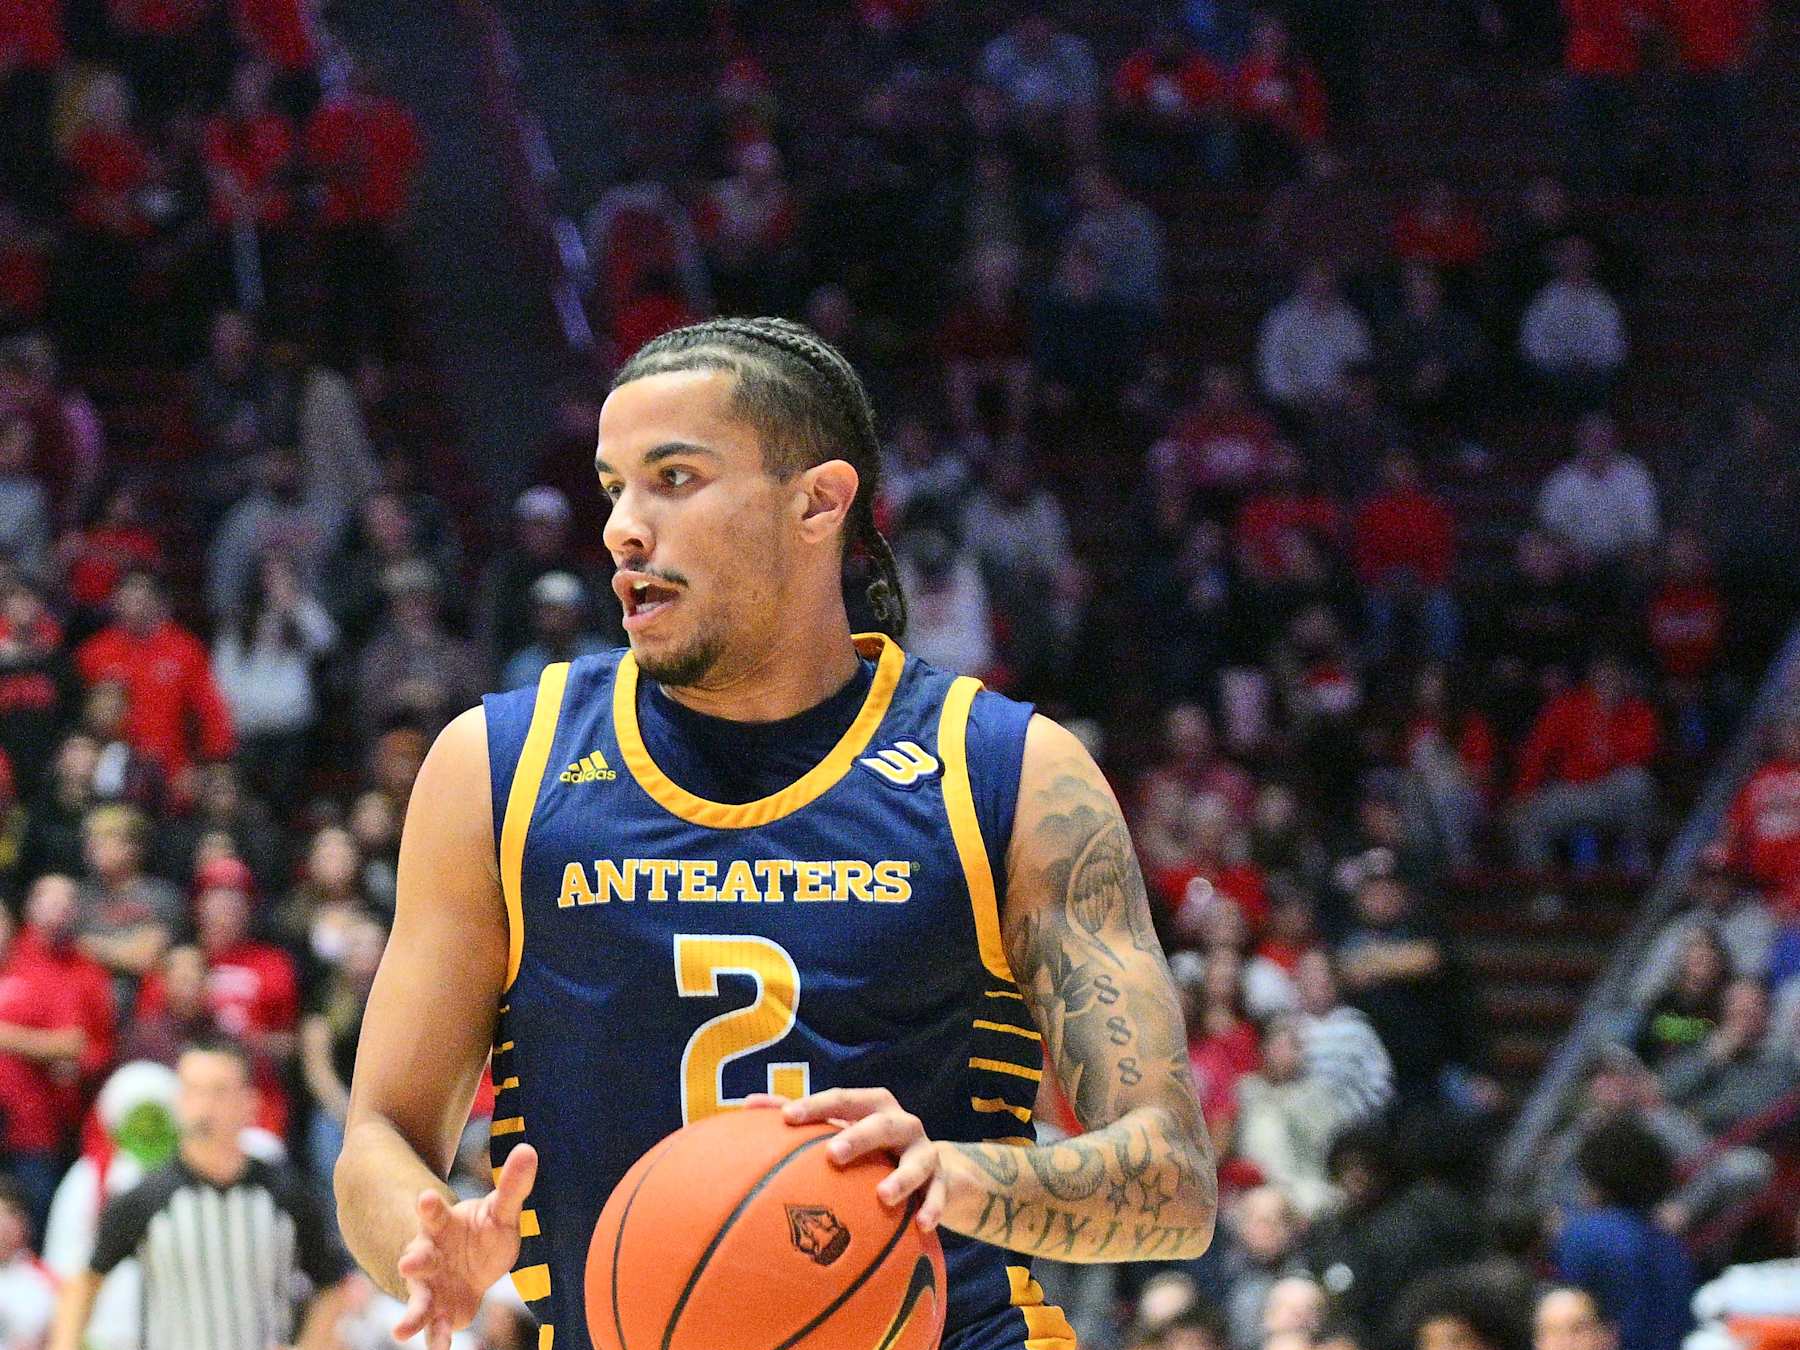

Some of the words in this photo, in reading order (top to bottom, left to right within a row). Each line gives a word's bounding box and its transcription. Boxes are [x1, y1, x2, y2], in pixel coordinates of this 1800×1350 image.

[560, 769, 616, 784] adidas
[558, 859, 912, 908] ANTEATERS
[673, 933, 810, 1128] 2
